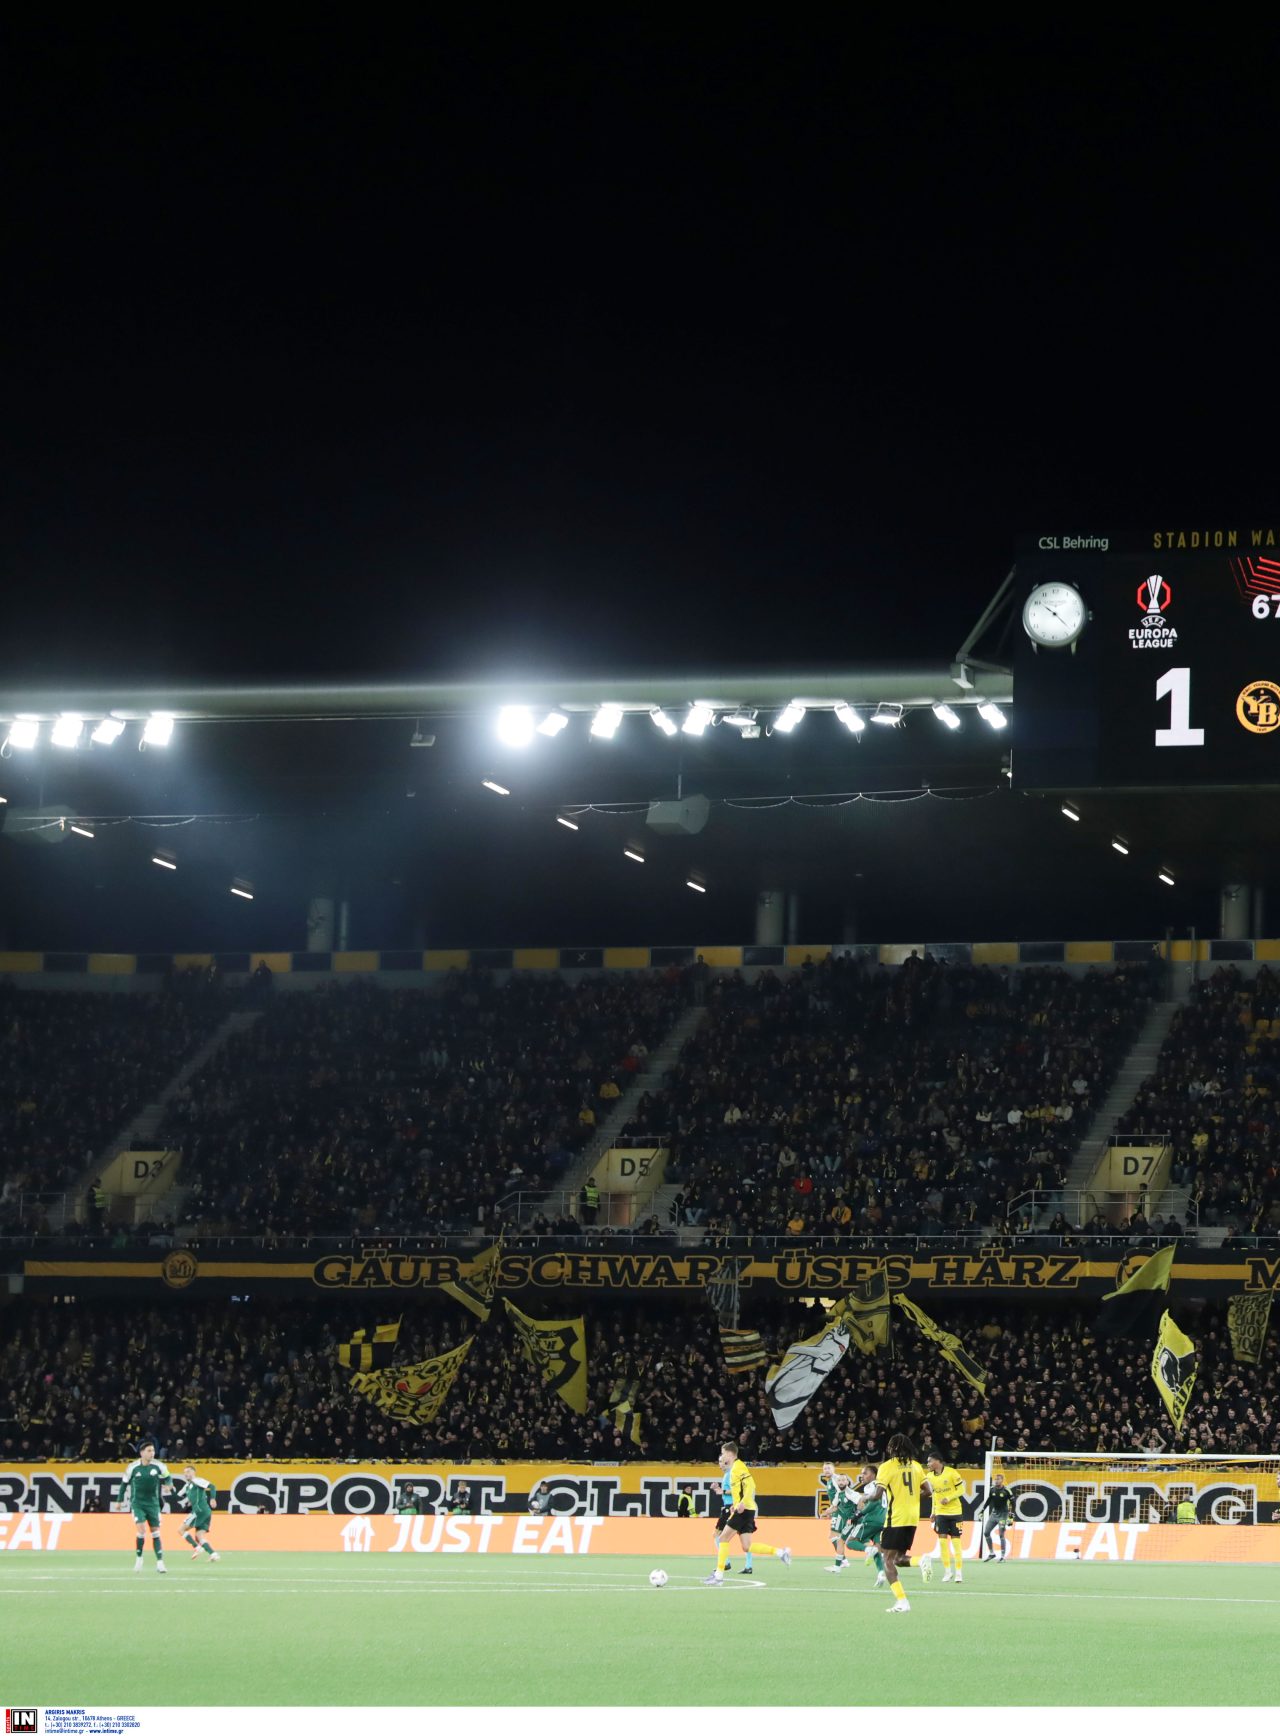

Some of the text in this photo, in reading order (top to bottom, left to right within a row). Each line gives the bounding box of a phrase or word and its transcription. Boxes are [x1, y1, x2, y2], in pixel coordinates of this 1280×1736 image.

[1038, 536, 1109, 551] CSL Behring
[1153, 530, 1238, 549] STADION
[1142, 617, 1164, 626] UEFA
[1128, 628, 1178, 639] EUROPA
[1132, 639, 1174, 649] LEAGUE
[1155, 667, 1205, 746] 1
[621, 1158, 651, 1176] D5
[1123, 1156, 1154, 1176] D7
[774, 1248, 912, 1289] ÜSES
[928, 1248, 1081, 1288] HÄRZ
[902, 1471, 914, 1496] 4
[226, 1472, 507, 1516] SPORT
[533, 1475, 758, 1518] CLU
[957, 1479, 1258, 1525] YOUNG
[387, 1515, 604, 1554] JUST EAT
[1055, 1523, 1150, 1561] EAT
